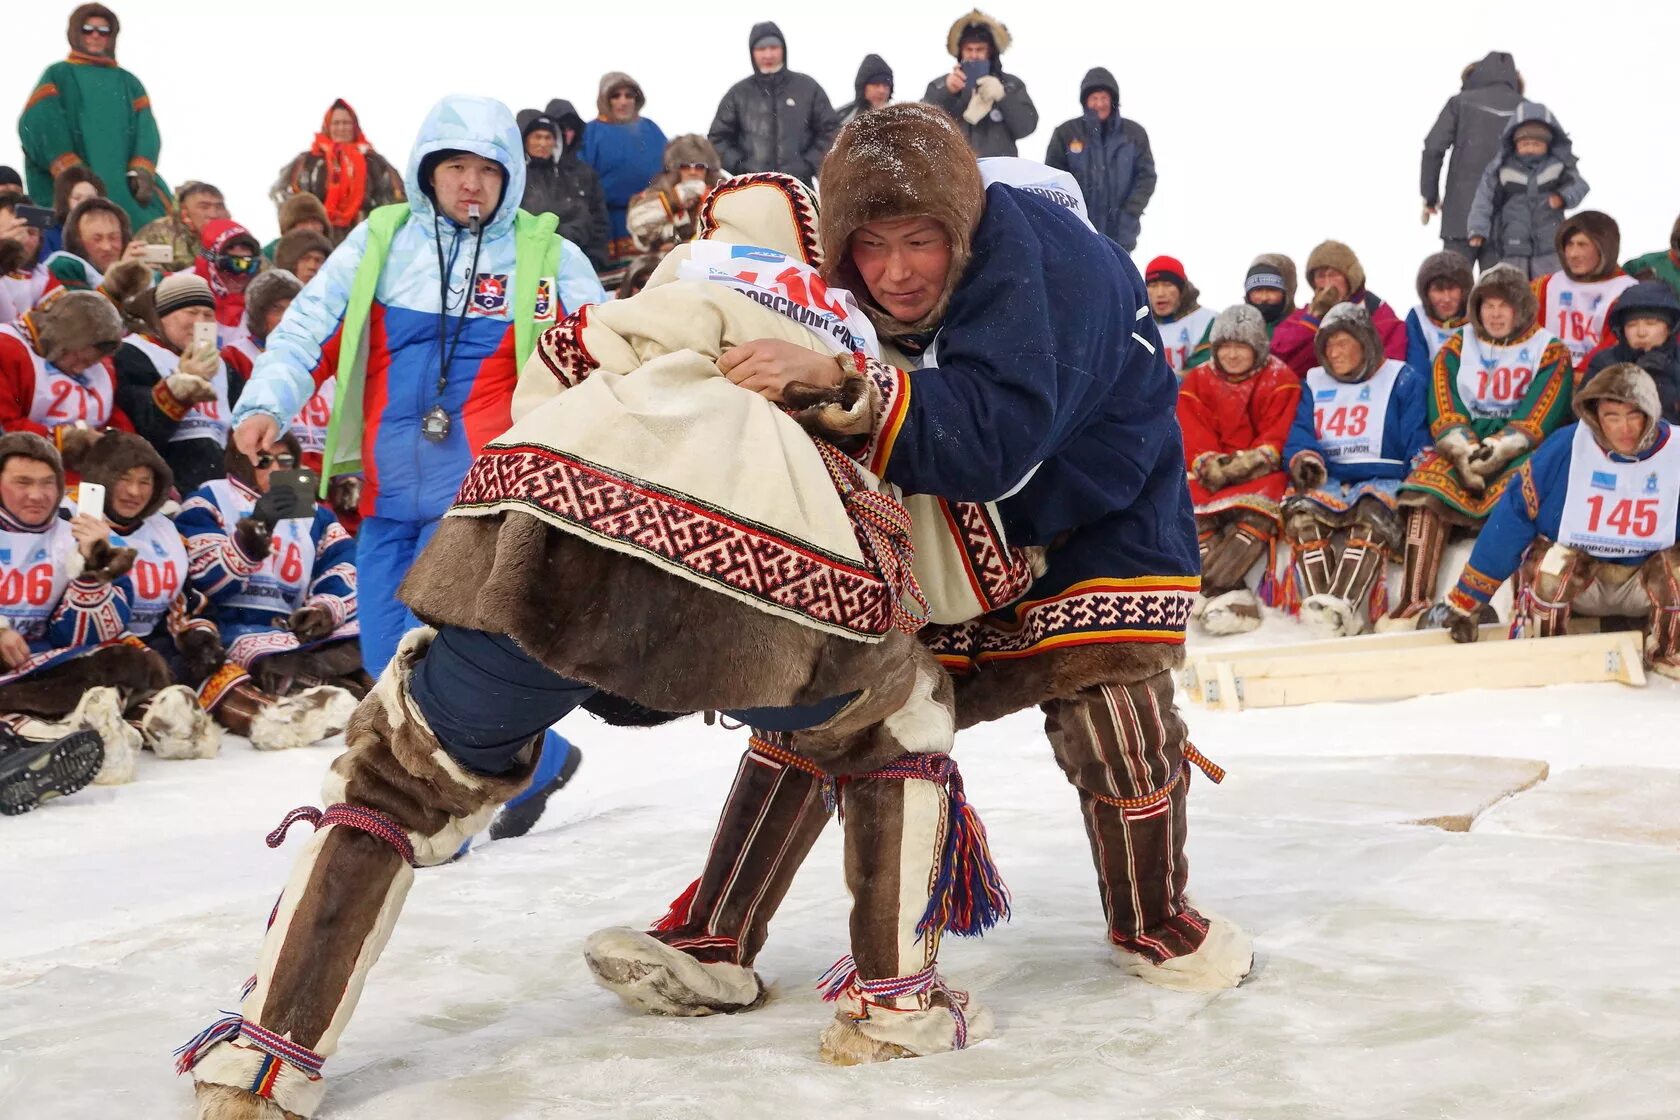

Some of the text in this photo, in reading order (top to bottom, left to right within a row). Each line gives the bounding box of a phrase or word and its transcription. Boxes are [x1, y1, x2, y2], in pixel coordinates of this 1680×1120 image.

[1476, 367, 1533, 400] 102
[1313, 405, 1369, 441] 143
[1587, 494, 1659, 538] 145
[0, 563, 54, 607] 06
[128, 559, 178, 600] 04
